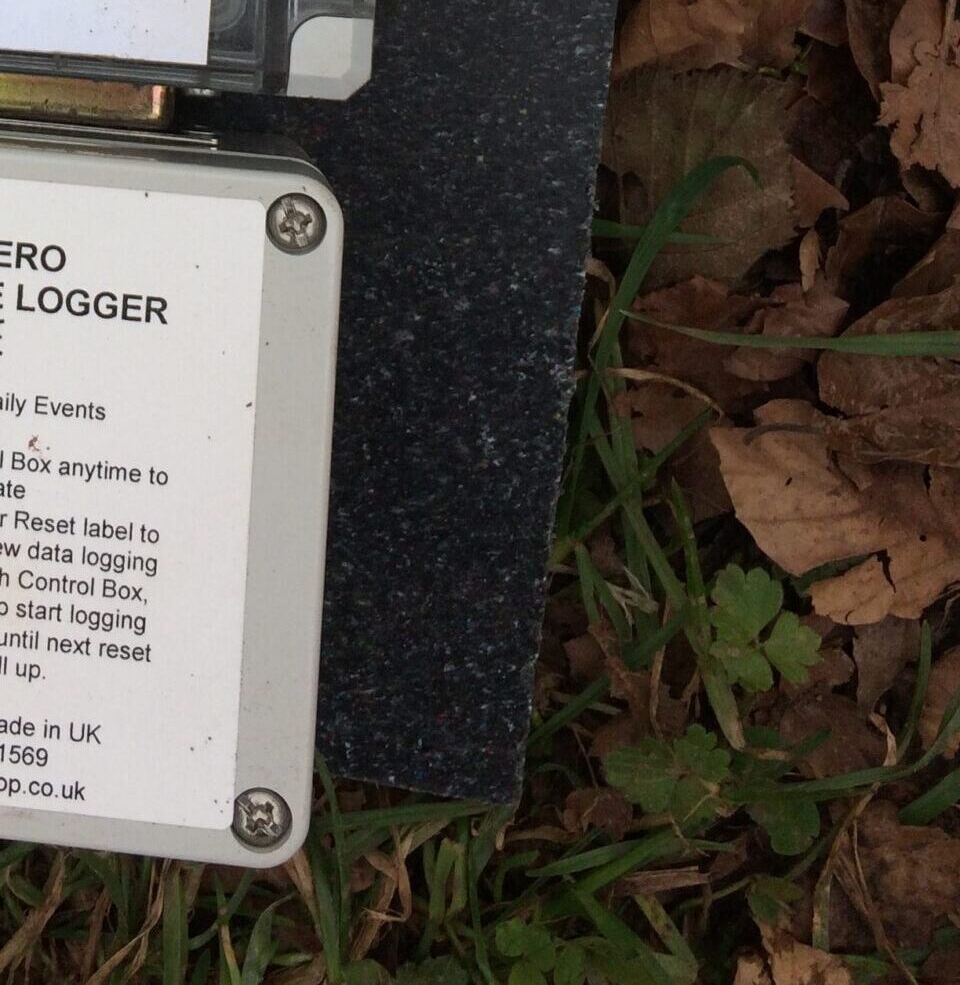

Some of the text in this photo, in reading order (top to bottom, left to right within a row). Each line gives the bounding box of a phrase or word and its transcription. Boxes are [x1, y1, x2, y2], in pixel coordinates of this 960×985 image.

[15, 282, 169, 326] LOGGER
[33, 394, 107, 422] Events
[10, 450, 52, 475] Box
[57, 459, 142, 484] anytime
[148, 466, 169, 487] to
[13, 509, 77, 536] Reset
[82, 516, 134, 542] label
[139, 523, 161, 545] to
[26, 540, 74, 565] data
[81, 545, 158, 578] logging
[17, 569, 96, 597] Control
[101, 577, 148, 606] Box,
[15, 599, 63, 623] start
[69, 603, 147, 637] logging
[46, 636, 92, 657] next
[98, 642, 152, 664] reset
[15, 661, 46, 684] up.
[42, 718, 61, 741] in
[68, 721, 102, 745] UK
